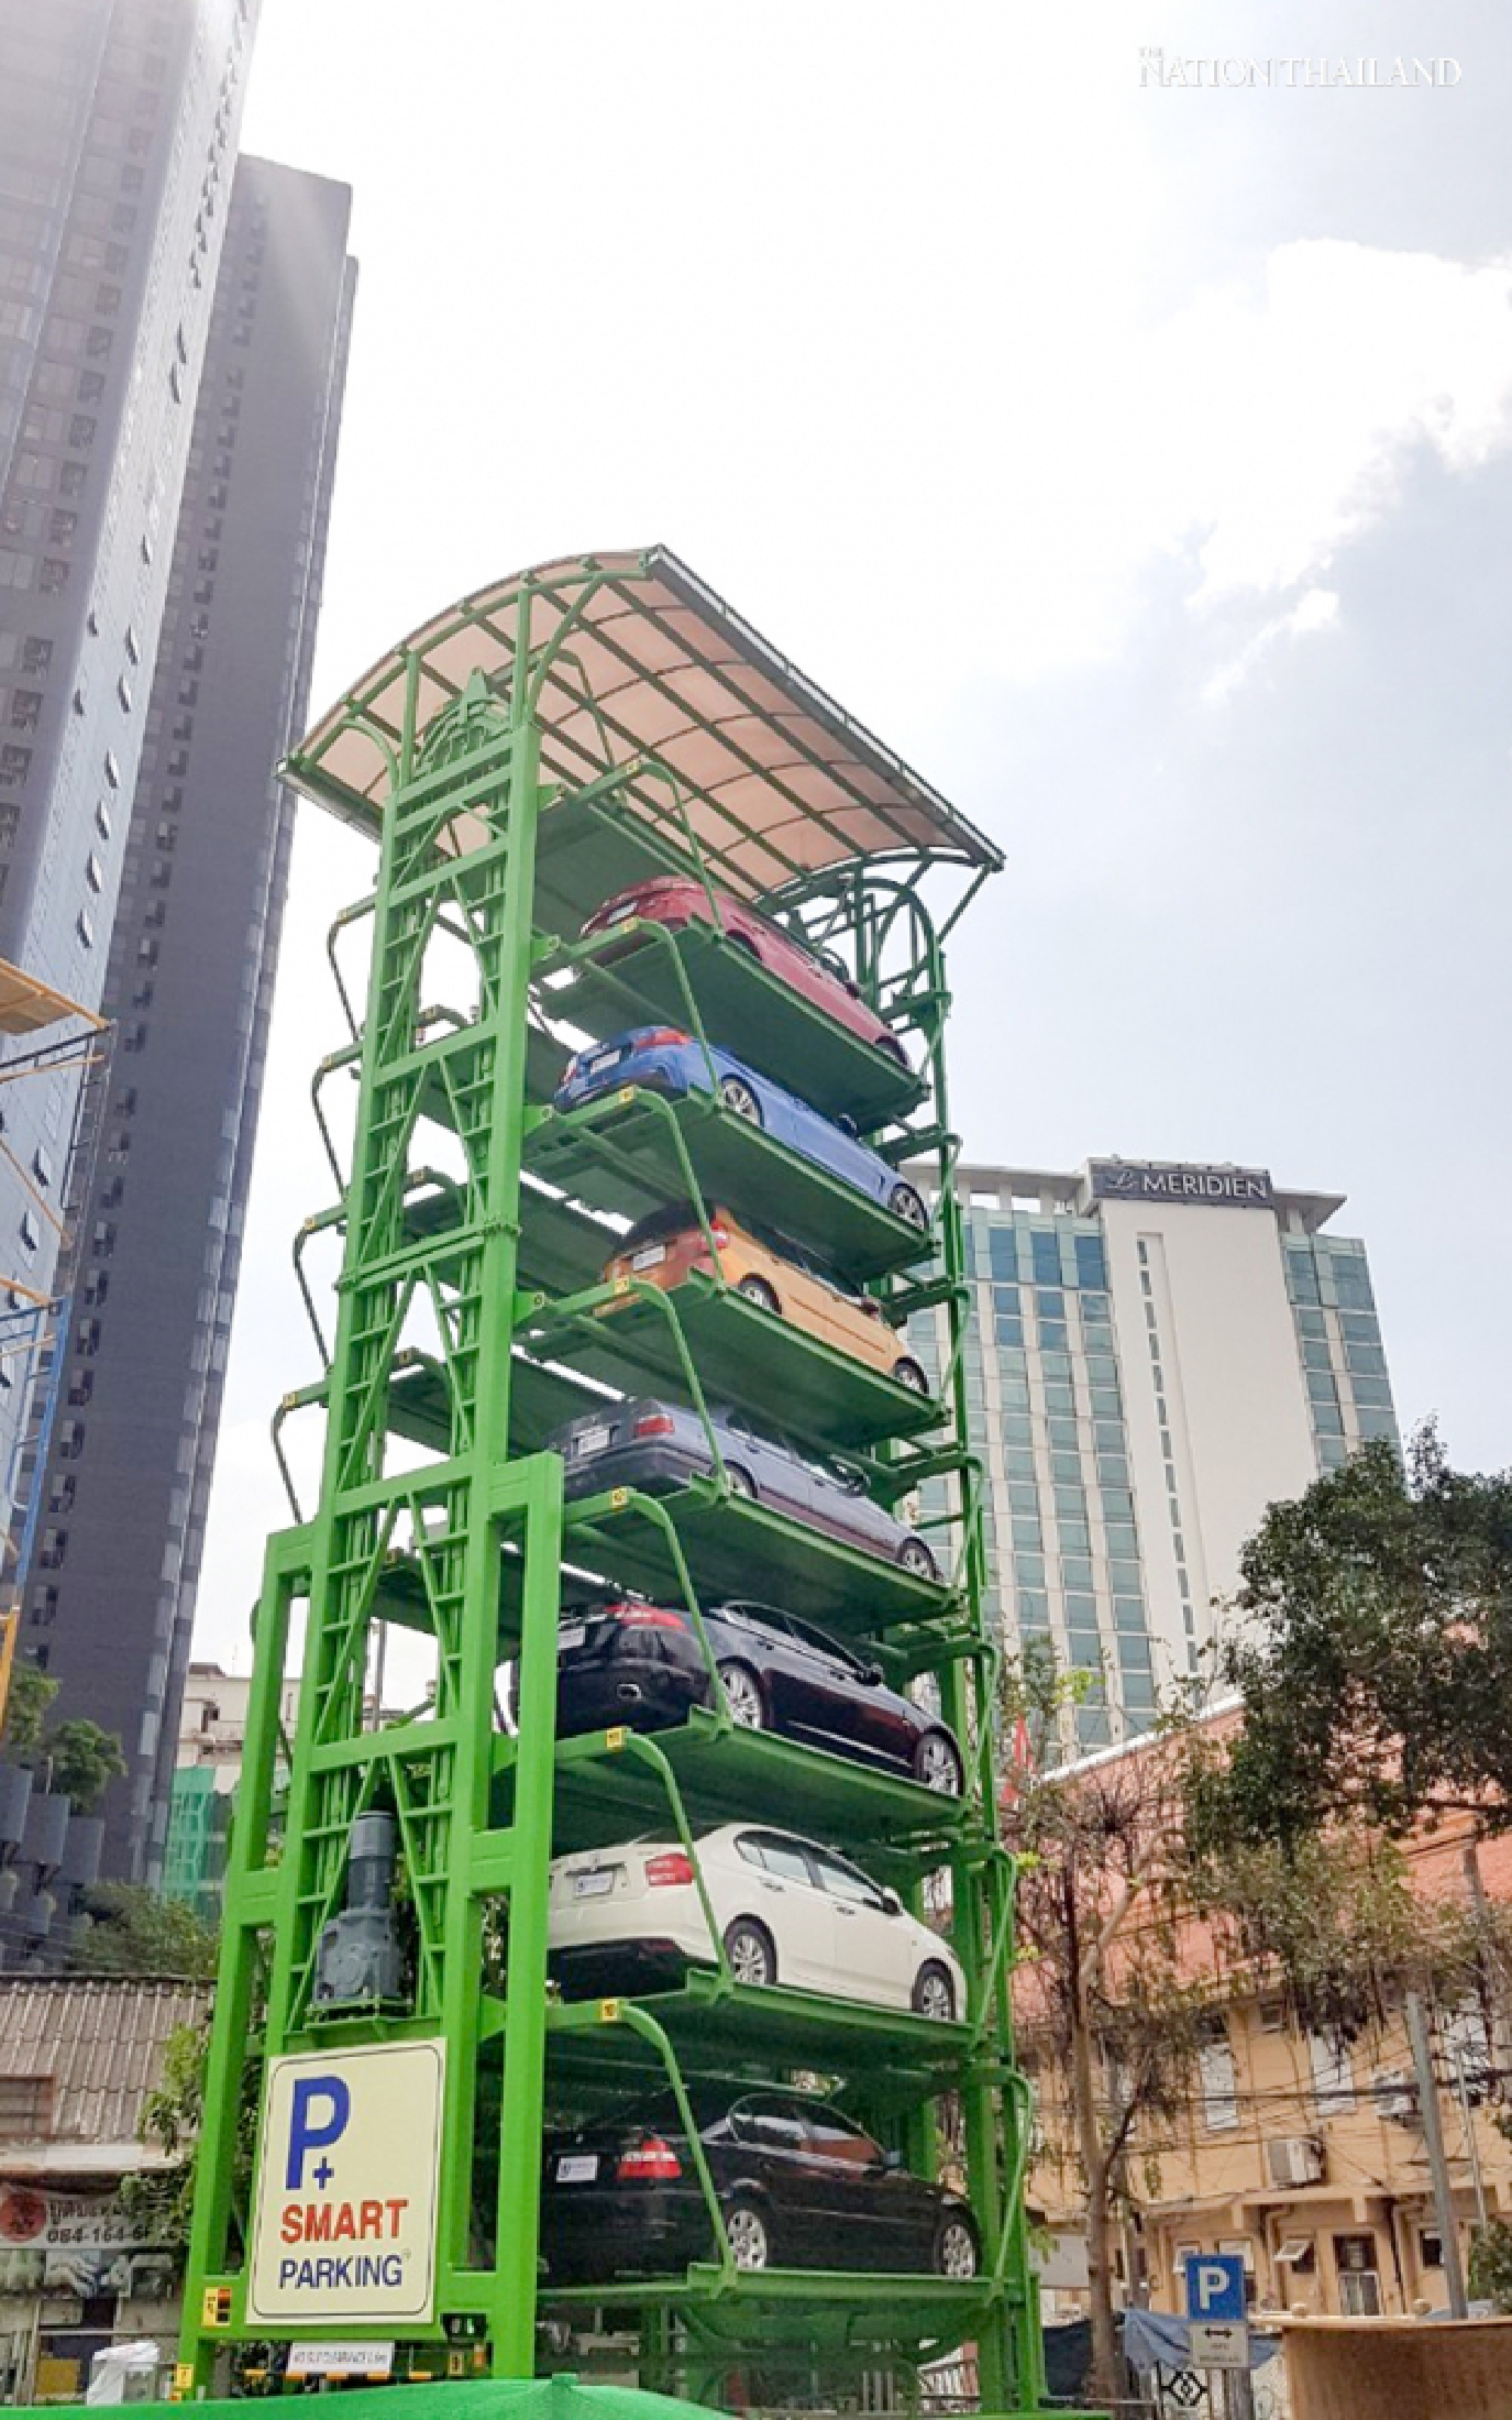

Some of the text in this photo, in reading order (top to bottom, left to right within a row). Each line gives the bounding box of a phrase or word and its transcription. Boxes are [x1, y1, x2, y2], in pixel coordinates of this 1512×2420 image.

[1144, 1173, 1267, 1199] MERIDIEN
[280, 2198, 410, 2245] SMART
[277, 2254, 403, 2290] PARKING
[1198, 2265, 1231, 2310] P
